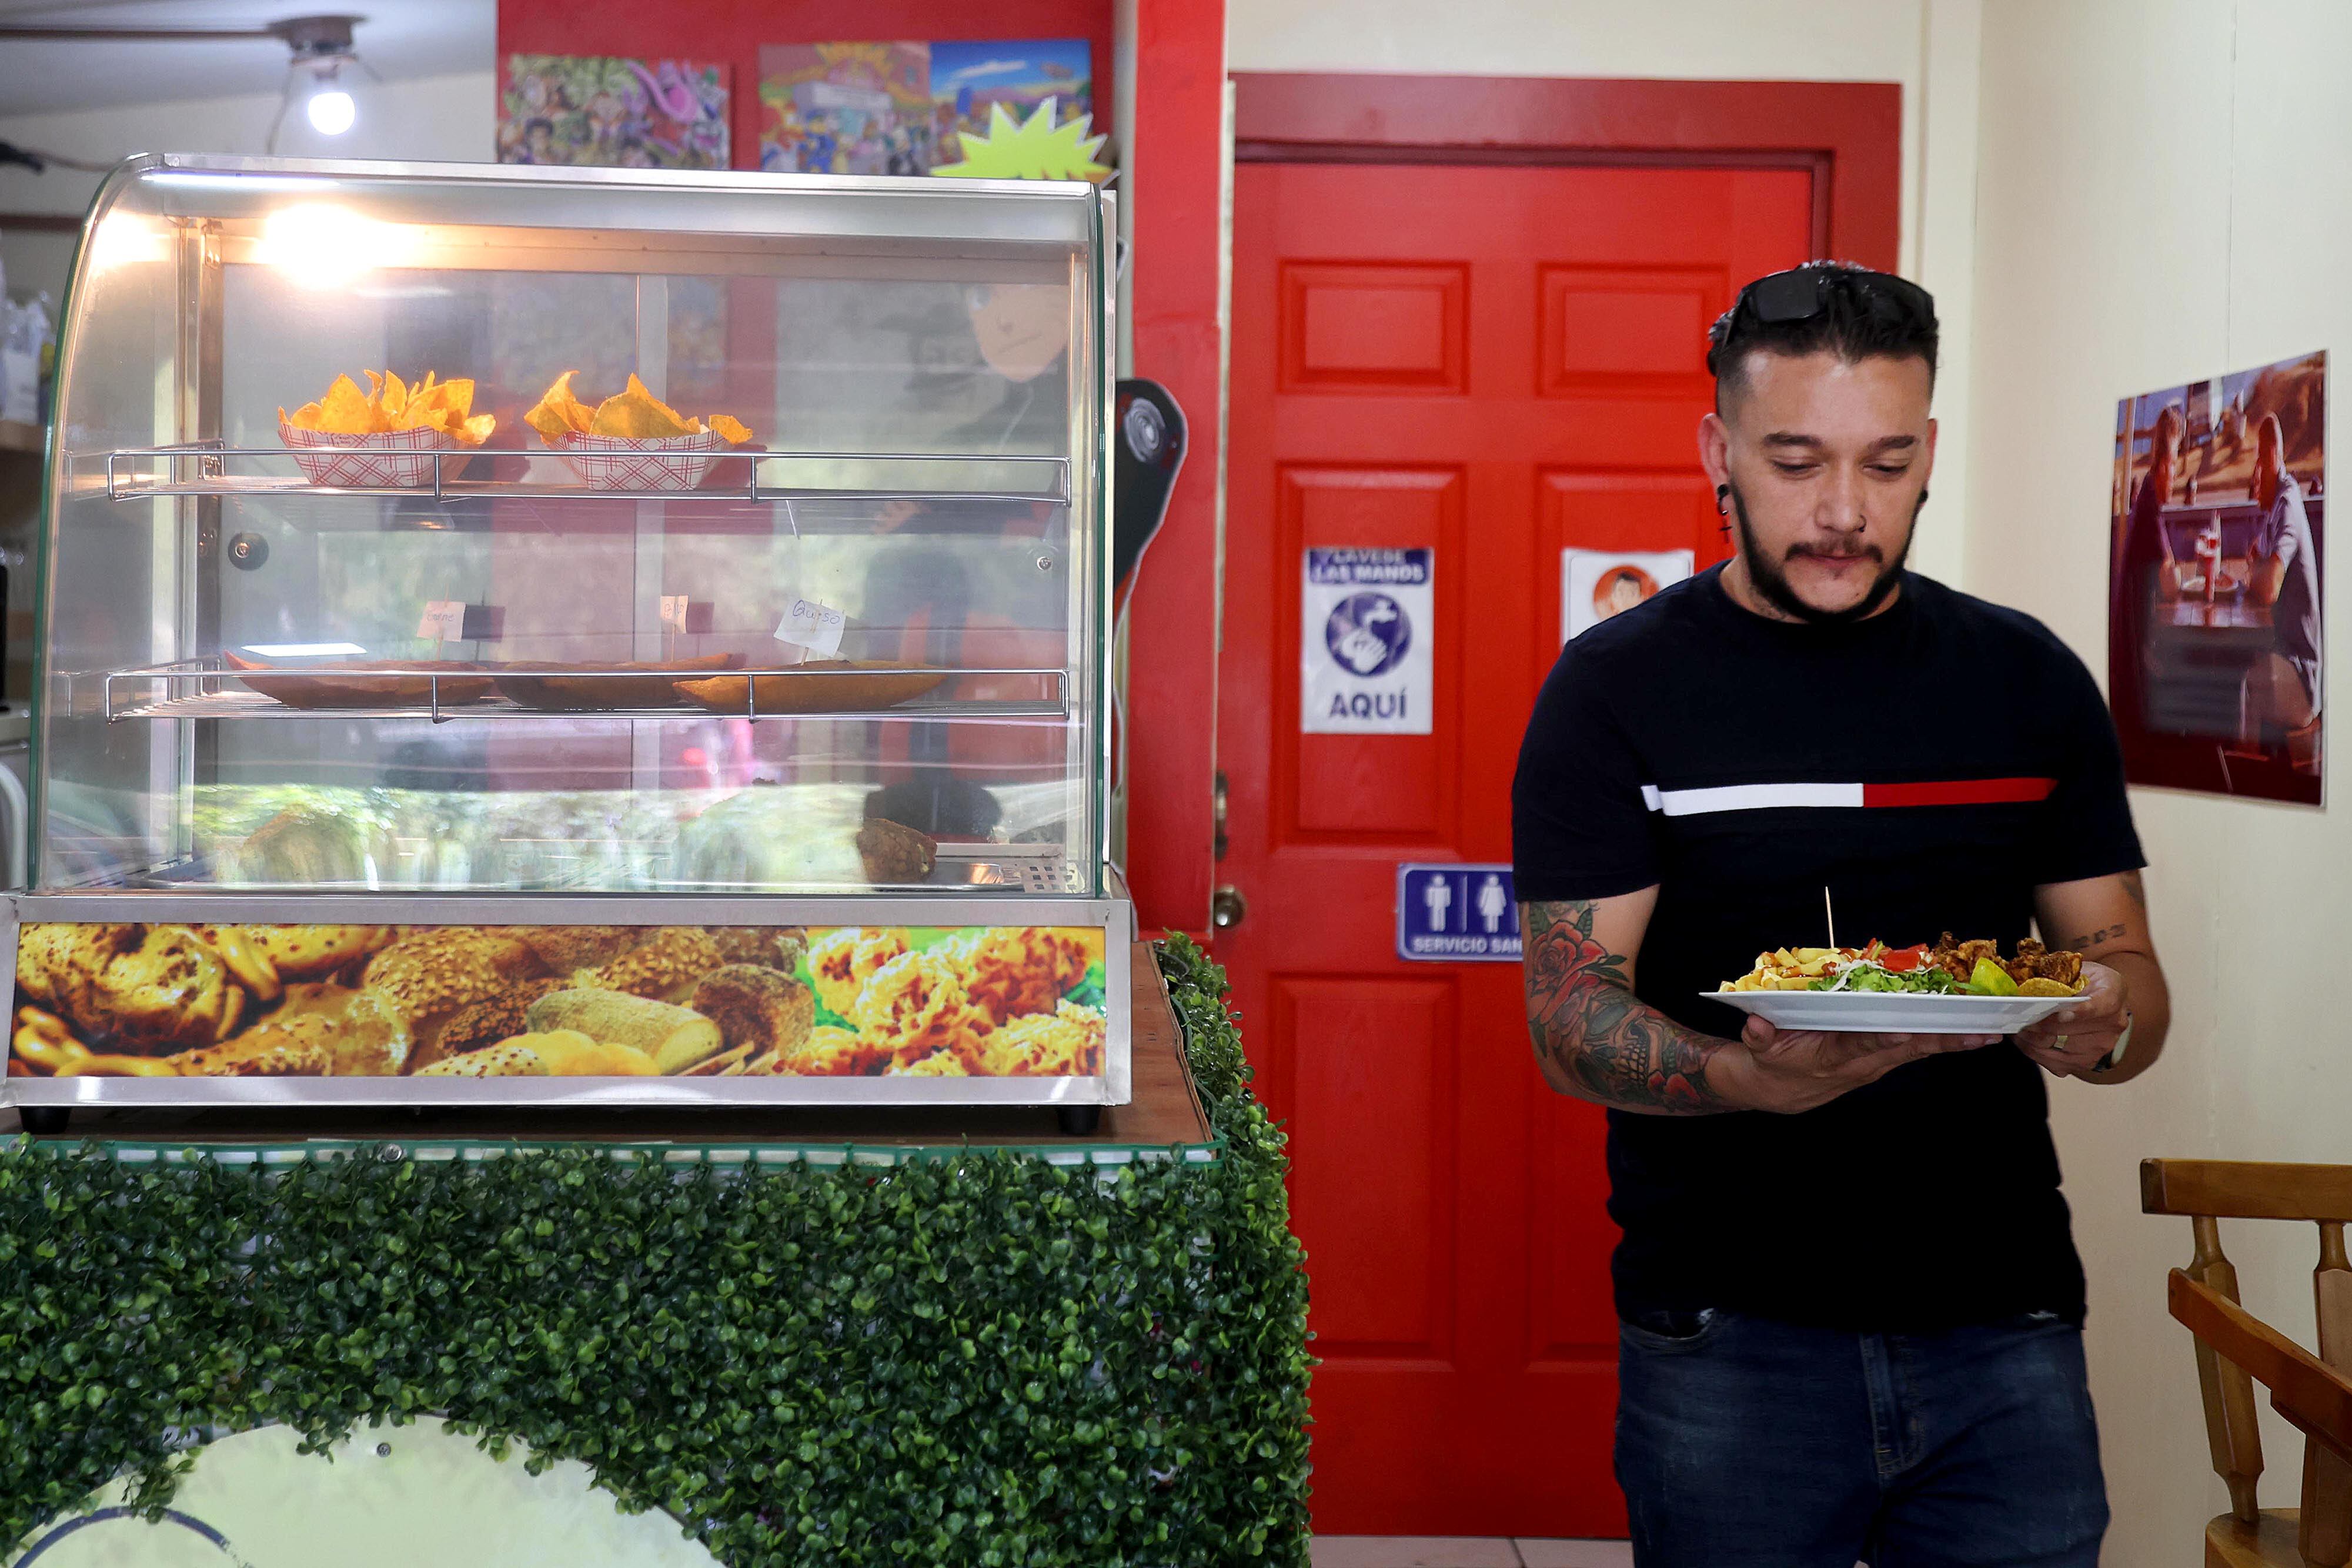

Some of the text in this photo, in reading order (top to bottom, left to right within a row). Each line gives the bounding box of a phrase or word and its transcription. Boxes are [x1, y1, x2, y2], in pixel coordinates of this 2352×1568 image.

[1311, 563, 1425, 581] LAS MANOS
[1328, 687, 1406, 720] AQUÍ
[1413, 937, 1489, 954] SERVICIO
